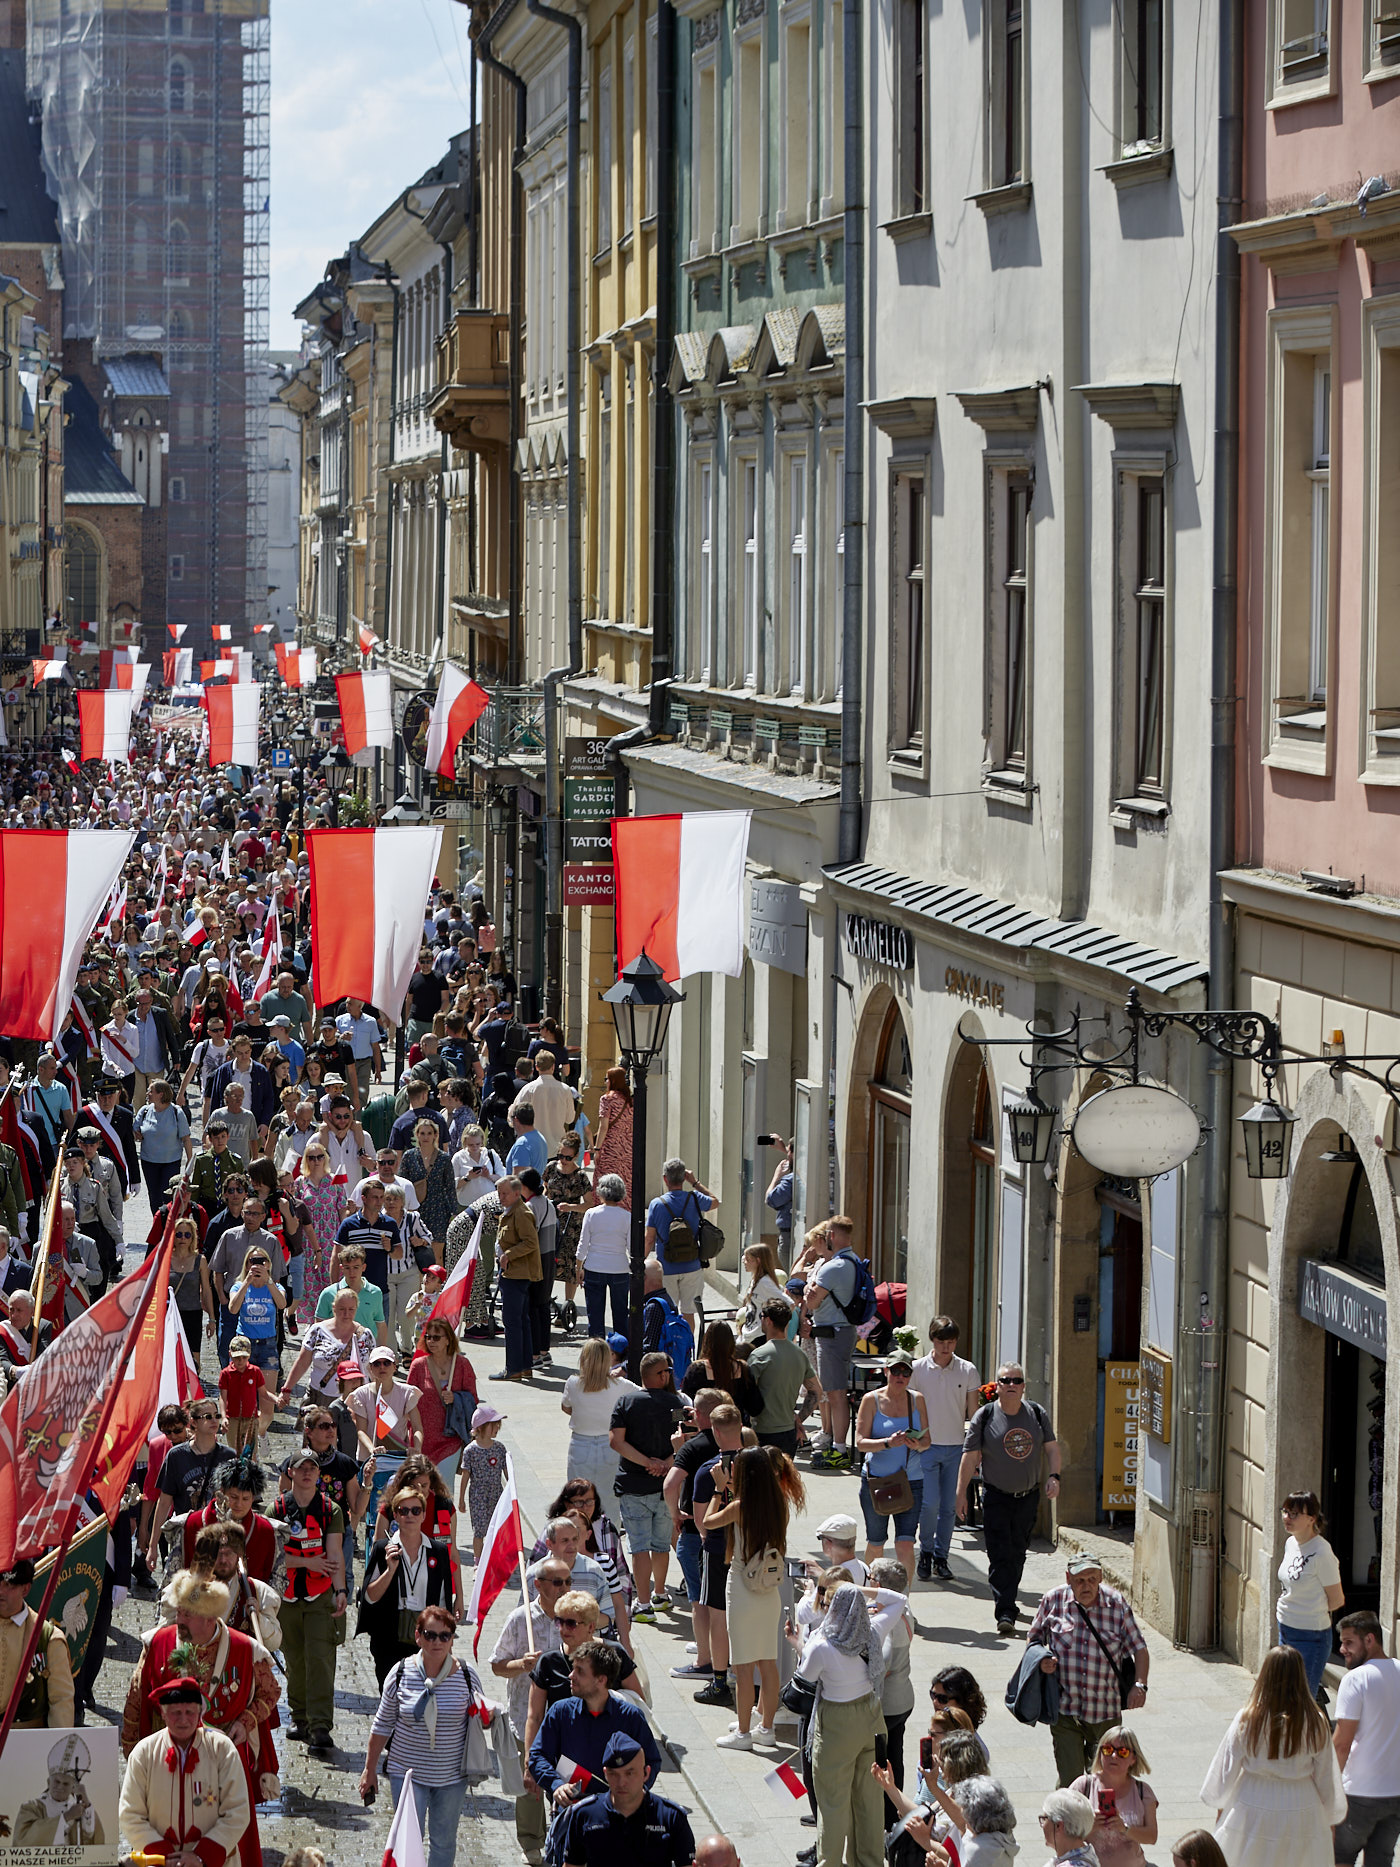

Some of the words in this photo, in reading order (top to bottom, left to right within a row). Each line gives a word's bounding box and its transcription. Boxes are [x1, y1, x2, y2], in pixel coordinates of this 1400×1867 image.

[587, 741, 605, 754] 36
[572, 756, 586, 764] ART
[568, 874, 615, 883] KANTO
[568, 886, 613, 895] EXCHANG
[845, 913, 908, 971] KARMELLO
[1017, 1131, 1033, 1147] 40
[1261, 1140, 1282, 1158] 42
[1304, 1277, 1340, 1322] KRAKÓW
[1124, 1422, 1137, 1435] E
[1114, 1441, 1123, 1449] 100
[1123, 1456, 1137, 1469] G
[10, 1848, 32, 1856] WAS
[35, 1845, 85, 1856] ZALEŻEĆ!
[11, 1857, 46, 1867] NASZE
